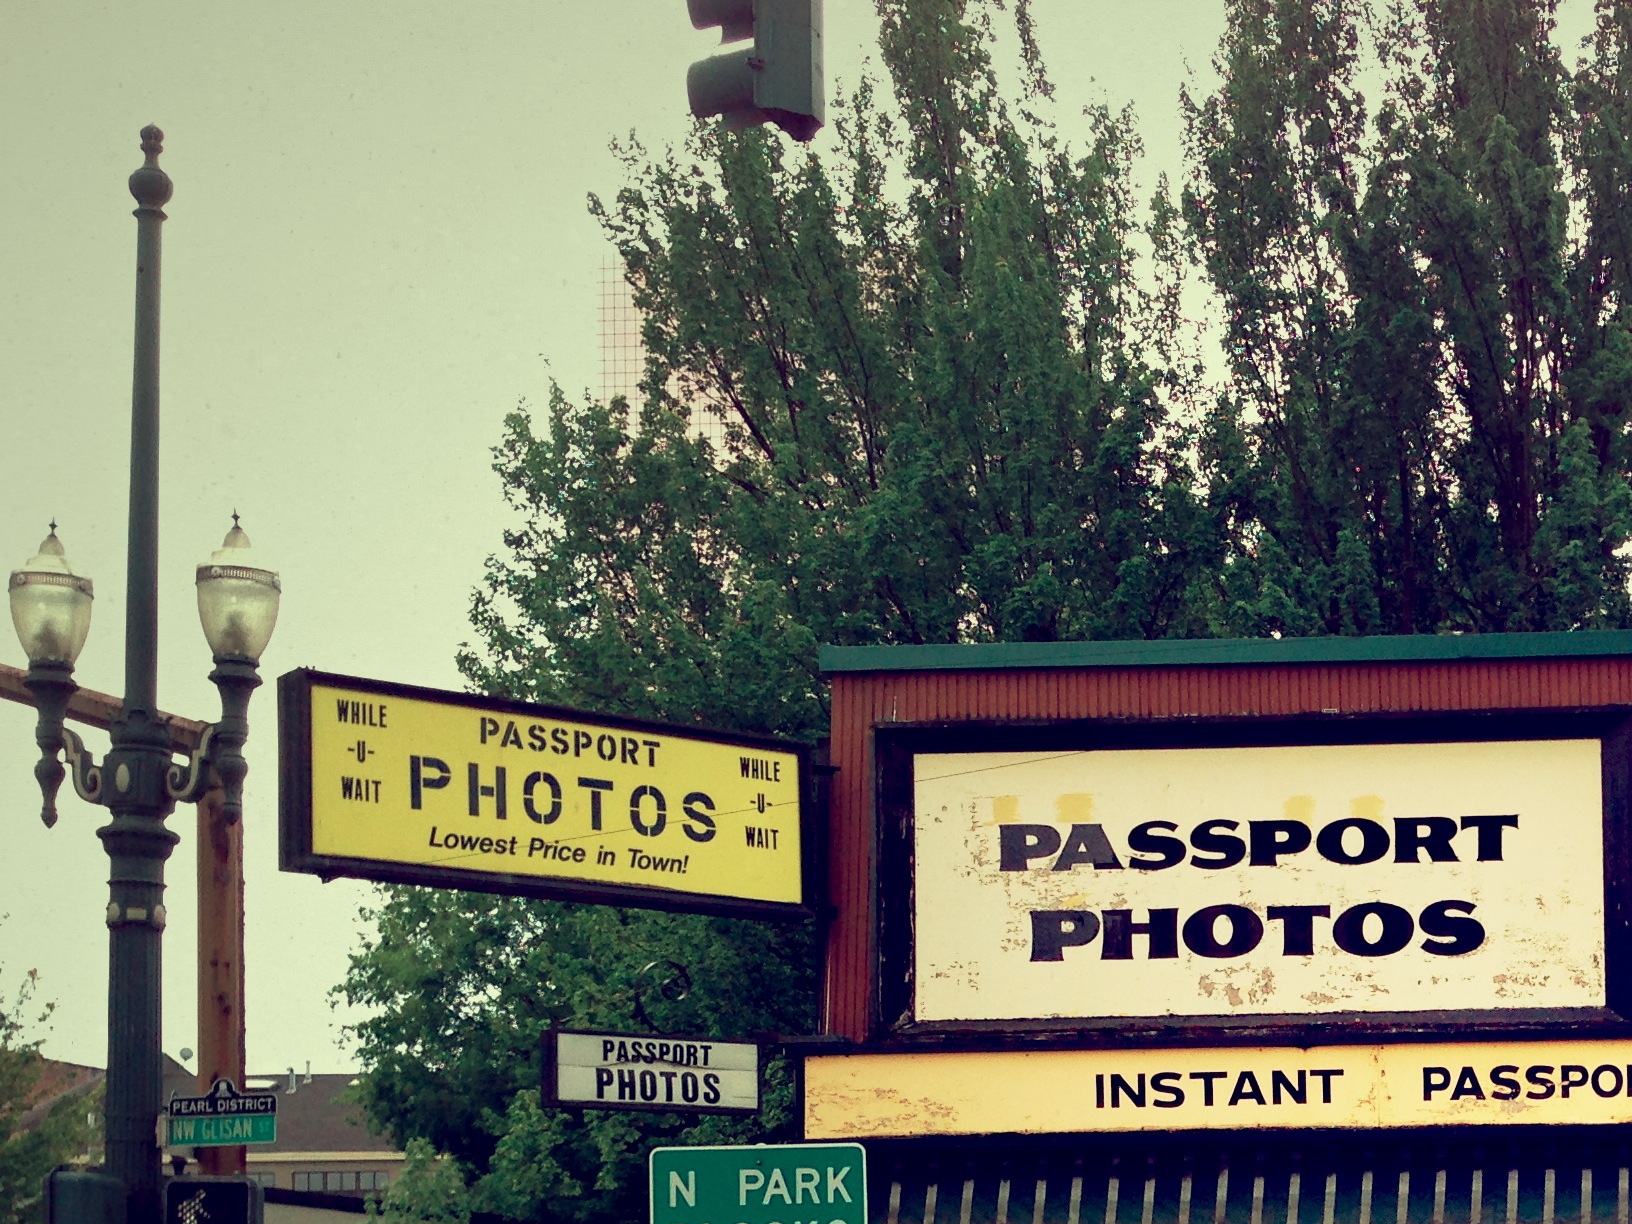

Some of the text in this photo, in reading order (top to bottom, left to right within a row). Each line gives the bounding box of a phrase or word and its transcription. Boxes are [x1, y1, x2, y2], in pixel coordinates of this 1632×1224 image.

[336, 698, 387, 730] WHILE
[478, 716, 662, 769] PASSPORT
[738, 756, 782, 783] WHILE
[340, 774, 382, 805] WAIT
[409, 753, 718, 844] PHOTOS
[427, 826, 690, 875] Lowest Price in Town!
[744, 825, 779, 851] WAIT
[998, 812, 1520, 873] PASSPORT
[1028, 899, 1487, 963] PHOTOS
[601, 1038, 713, 1067] PASSPORT
[595, 1068, 722, 1104] PHOTOS
[1094, 1068, 1345, 1109] INSTANT
[172, 1097, 273, 1114] PEARL DISTRICT
[173, 1119, 196, 1140] NW
[202, 1117, 253, 1140] GLISAN
[668, 1165, 853, 1207] N PARK
